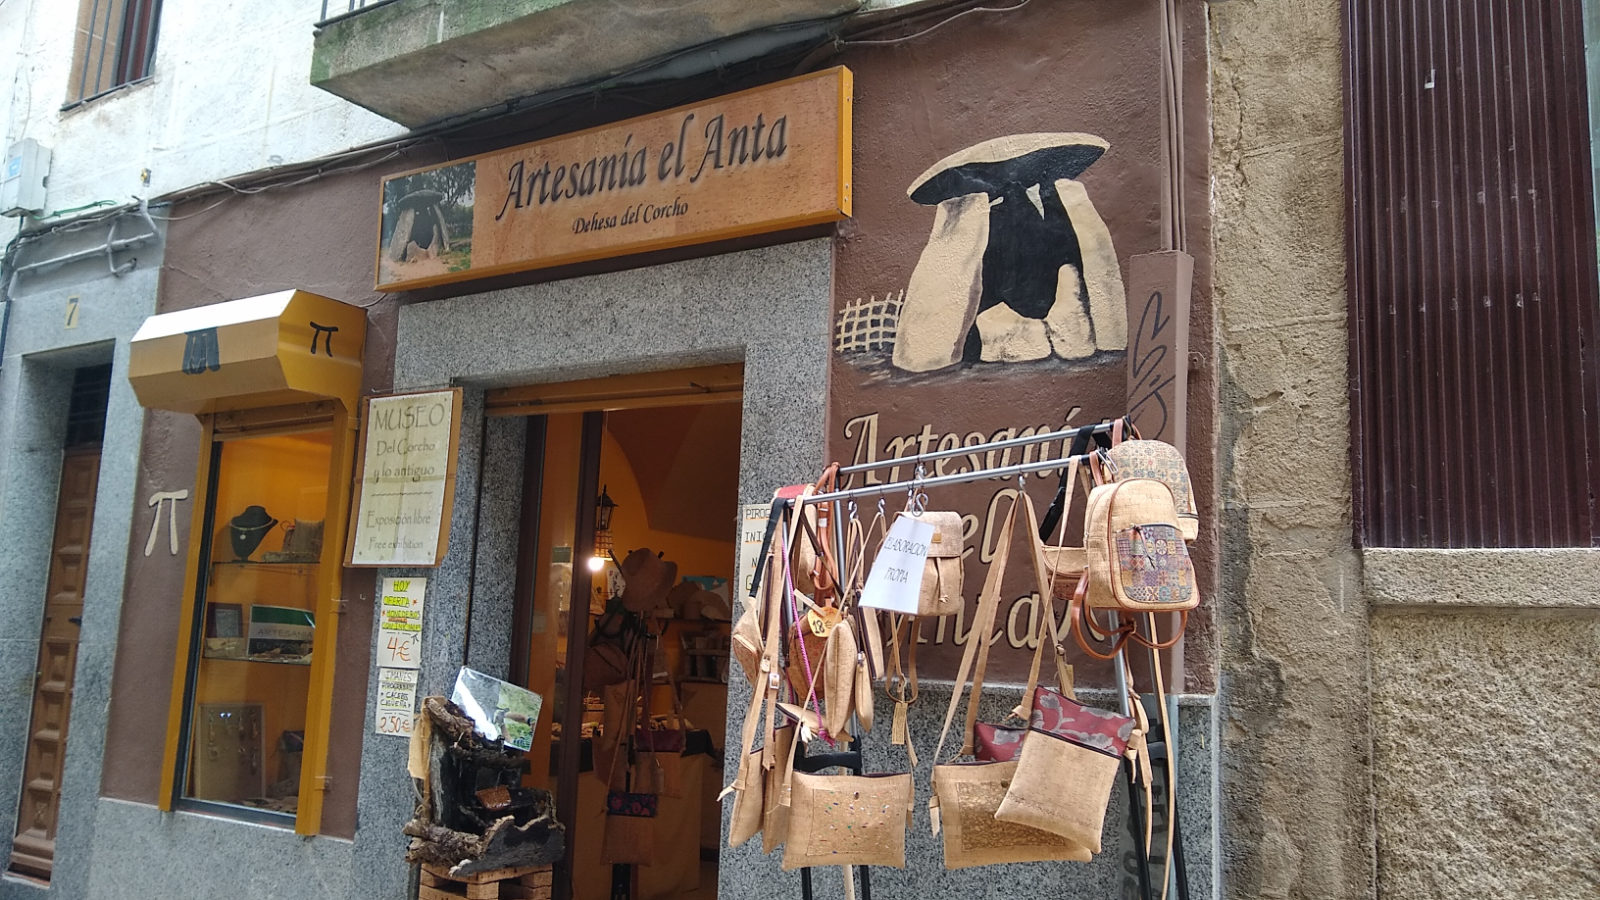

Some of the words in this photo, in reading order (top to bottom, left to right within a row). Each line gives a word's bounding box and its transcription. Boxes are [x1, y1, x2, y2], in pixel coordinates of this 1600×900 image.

[496, 133, 647, 220] Artesanía
[657, 113, 695, 181] el
[689, 112, 787, 183] Anta
[572, 211, 618, 234] Dehesa
[620, 201, 641, 226] del
[642, 196, 688, 224] Corcho
[67, 298, 79, 326] 7
[374, 403, 445, 431] MUSEO
[376, 440, 396, 457] Del
[397, 437, 436, 456] Corcho
[841, 405, 1111, 491] Artesaní
[373, 469, 380, 484] y
[381, 461, 392, 477] lo
[393, 464, 435, 483] antiguo
[366, 508, 412, 532] Exposición
[413, 508, 432, 525] libre
[368, 536, 387, 551] Free
[387, 536, 424, 550] exhibition
[393, 581, 410, 592] HOY
